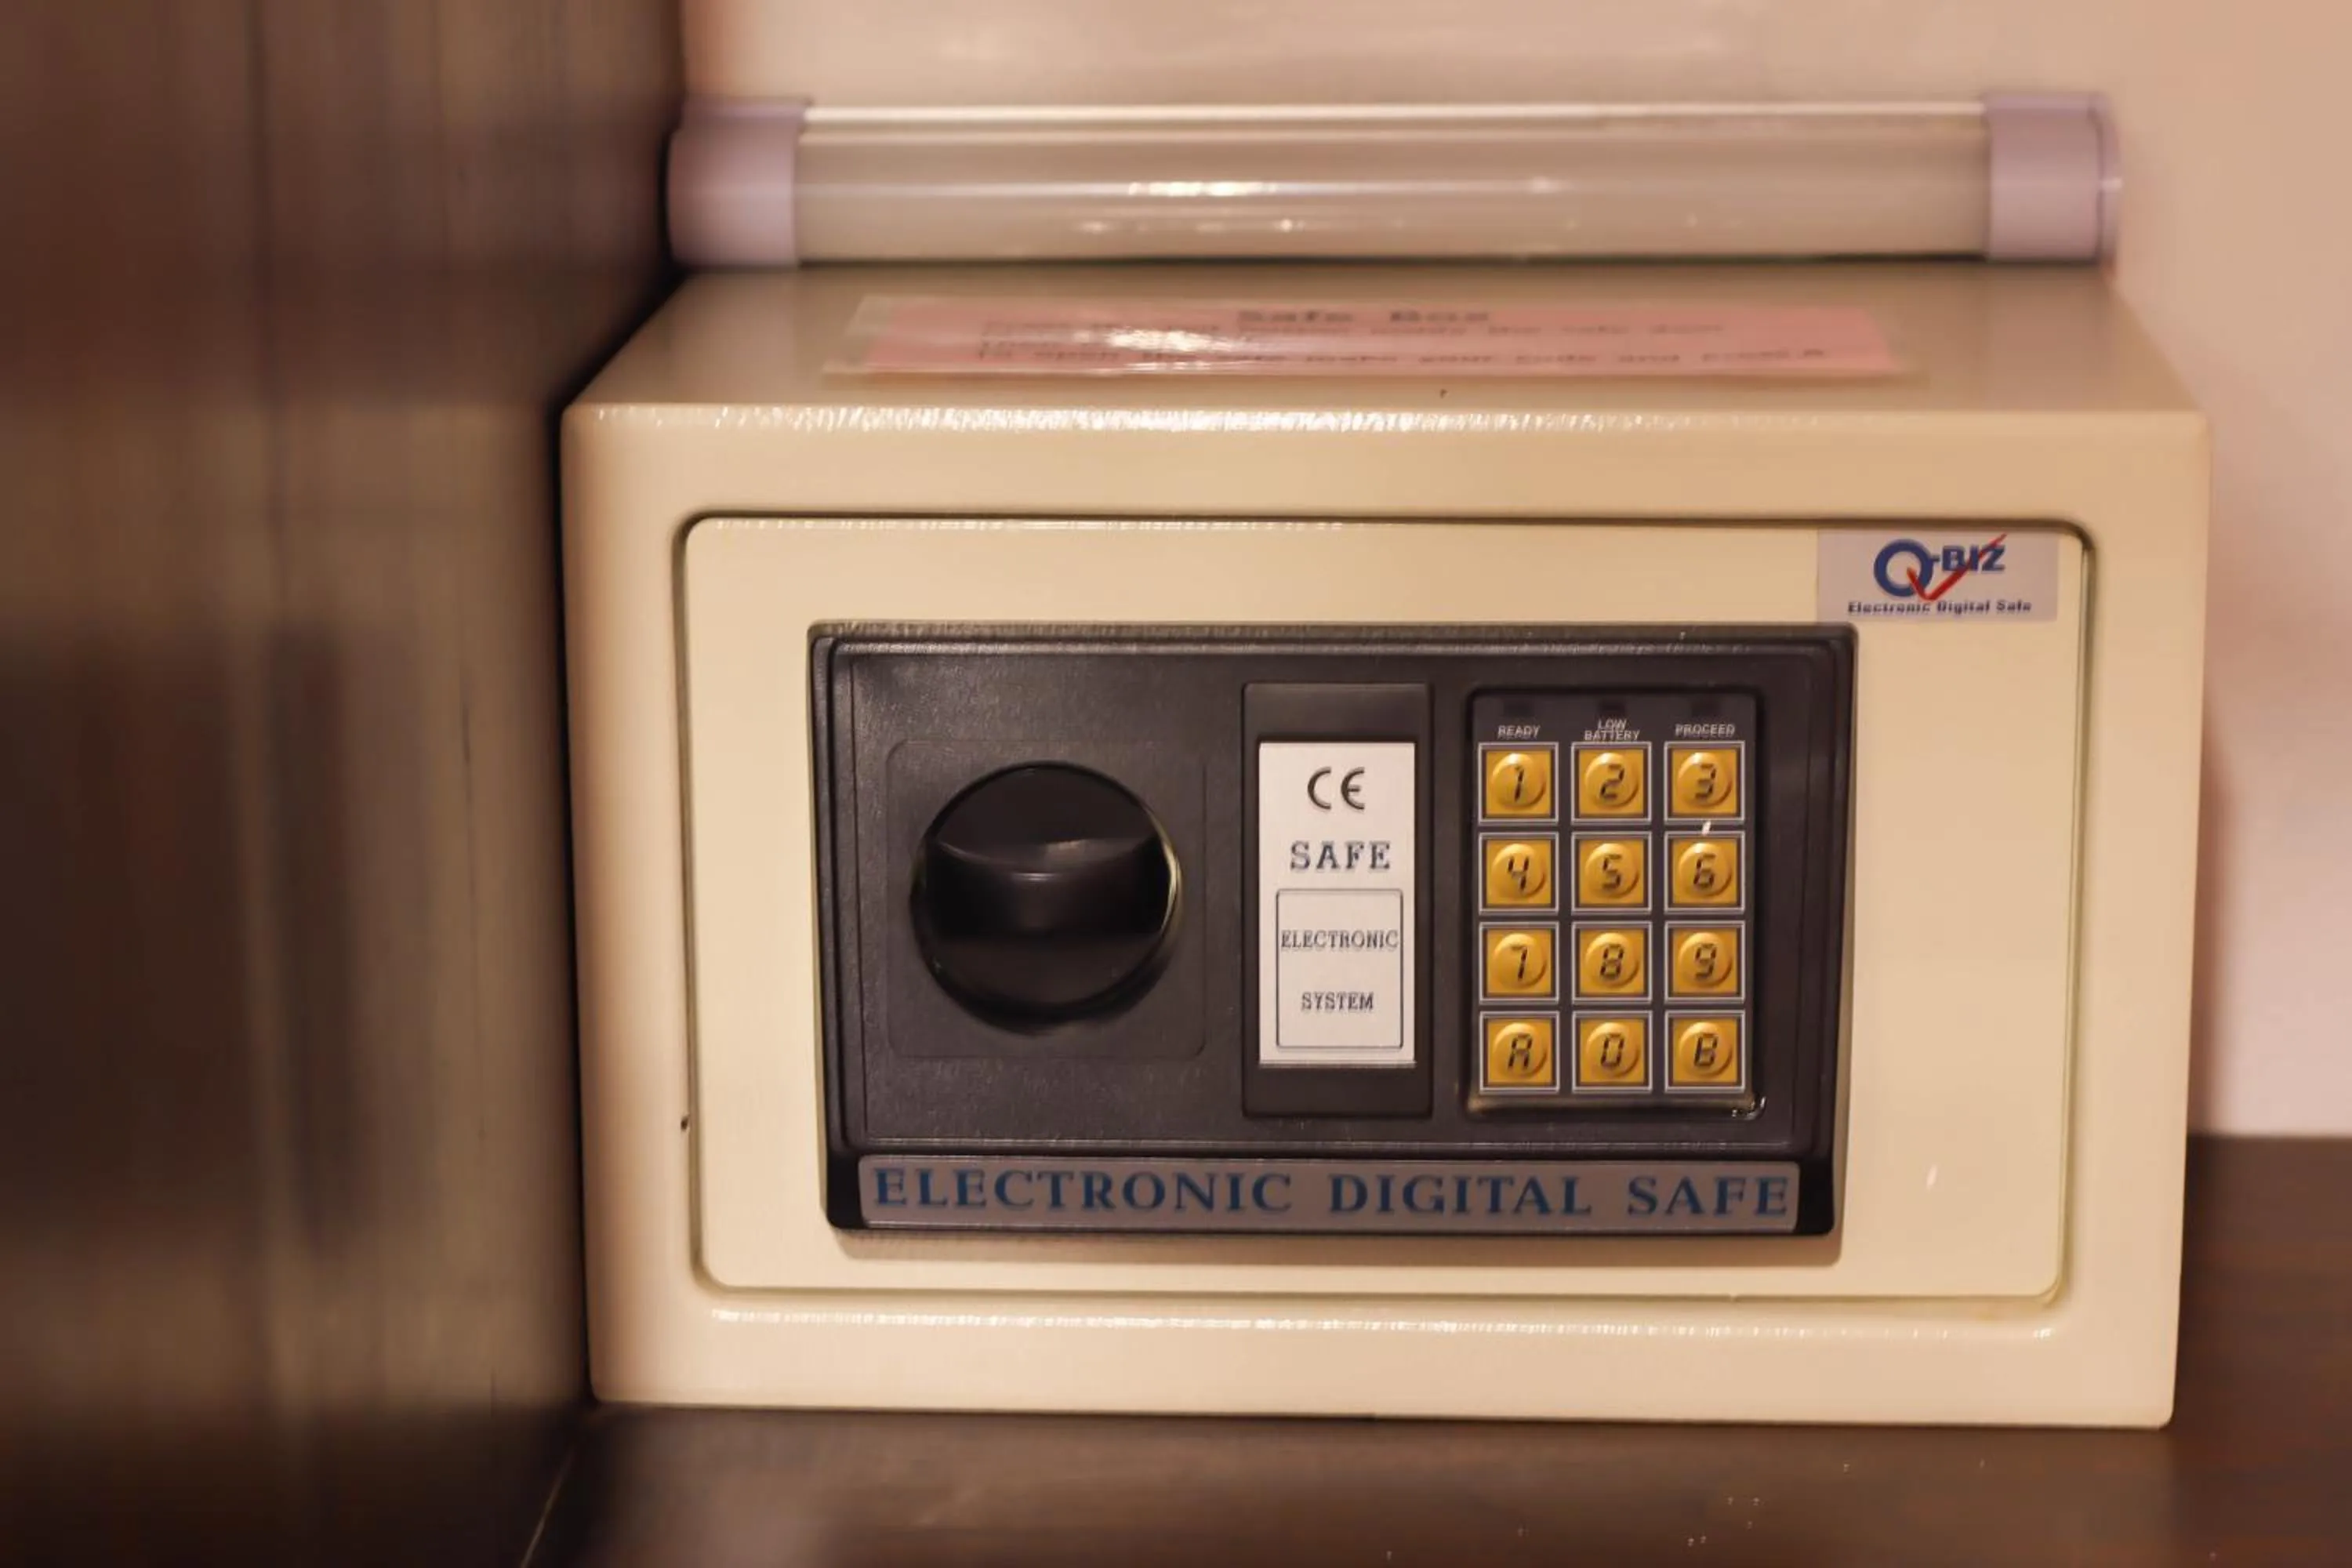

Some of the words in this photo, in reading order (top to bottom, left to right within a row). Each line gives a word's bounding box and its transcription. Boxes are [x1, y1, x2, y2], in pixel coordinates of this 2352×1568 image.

[1847, 601, 1931, 615] Electronic
[1936, 601, 1991, 615] Digital
[1995, 599, 2032, 612] Safe
[1497, 725, 1541, 737] READY
[1584, 730, 1640, 741] BATTERY
[1598, 718, 1628, 730] LOW
[1675, 724, 1736, 735] PROCEED
[1306, 766, 1366, 810] CE
[1513, 764, 1525, 803] 1
[1599, 762, 1625, 800] 2
[1694, 763, 1718, 800] 3
[1290, 840, 1392, 871] SAFE
[1506, 855, 1530, 891] 4
[1601, 854, 1623, 890] 5
[1693, 853, 1716, 890] 6
[1280, 929, 1399, 949] ELECTRONIC
[1510, 945, 1528, 981] 7
[1599, 942, 1624, 980] 8
[1694, 942, 1718, 978] 9
[1301, 991, 1375, 1011] SYSTEM
[1507, 1032, 1533, 1070] A
[1693, 1032, 1719, 1067] B
[873, 1167, 1292, 1213] ELECTRONIC
[1327, 1173, 1593, 1217] DIGITAL
[1626, 1174, 1789, 1218] SAFE
